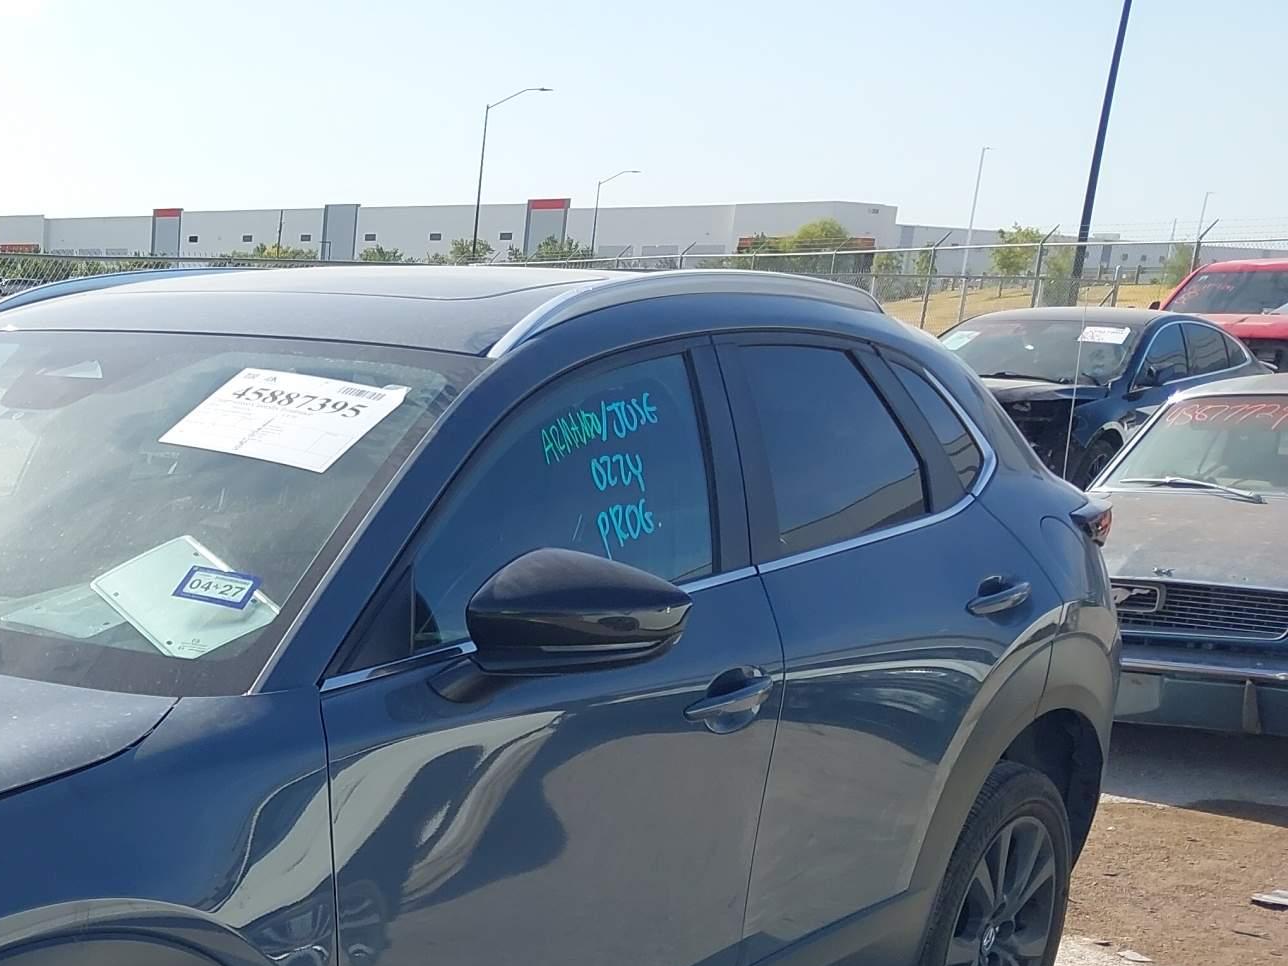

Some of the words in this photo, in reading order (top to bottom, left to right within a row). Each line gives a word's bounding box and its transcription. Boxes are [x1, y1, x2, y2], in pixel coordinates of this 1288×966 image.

[231, 386, 369, 419] 45887395
[189, 578, 213, 592] 04
[218, 584, 247, 597] 27
